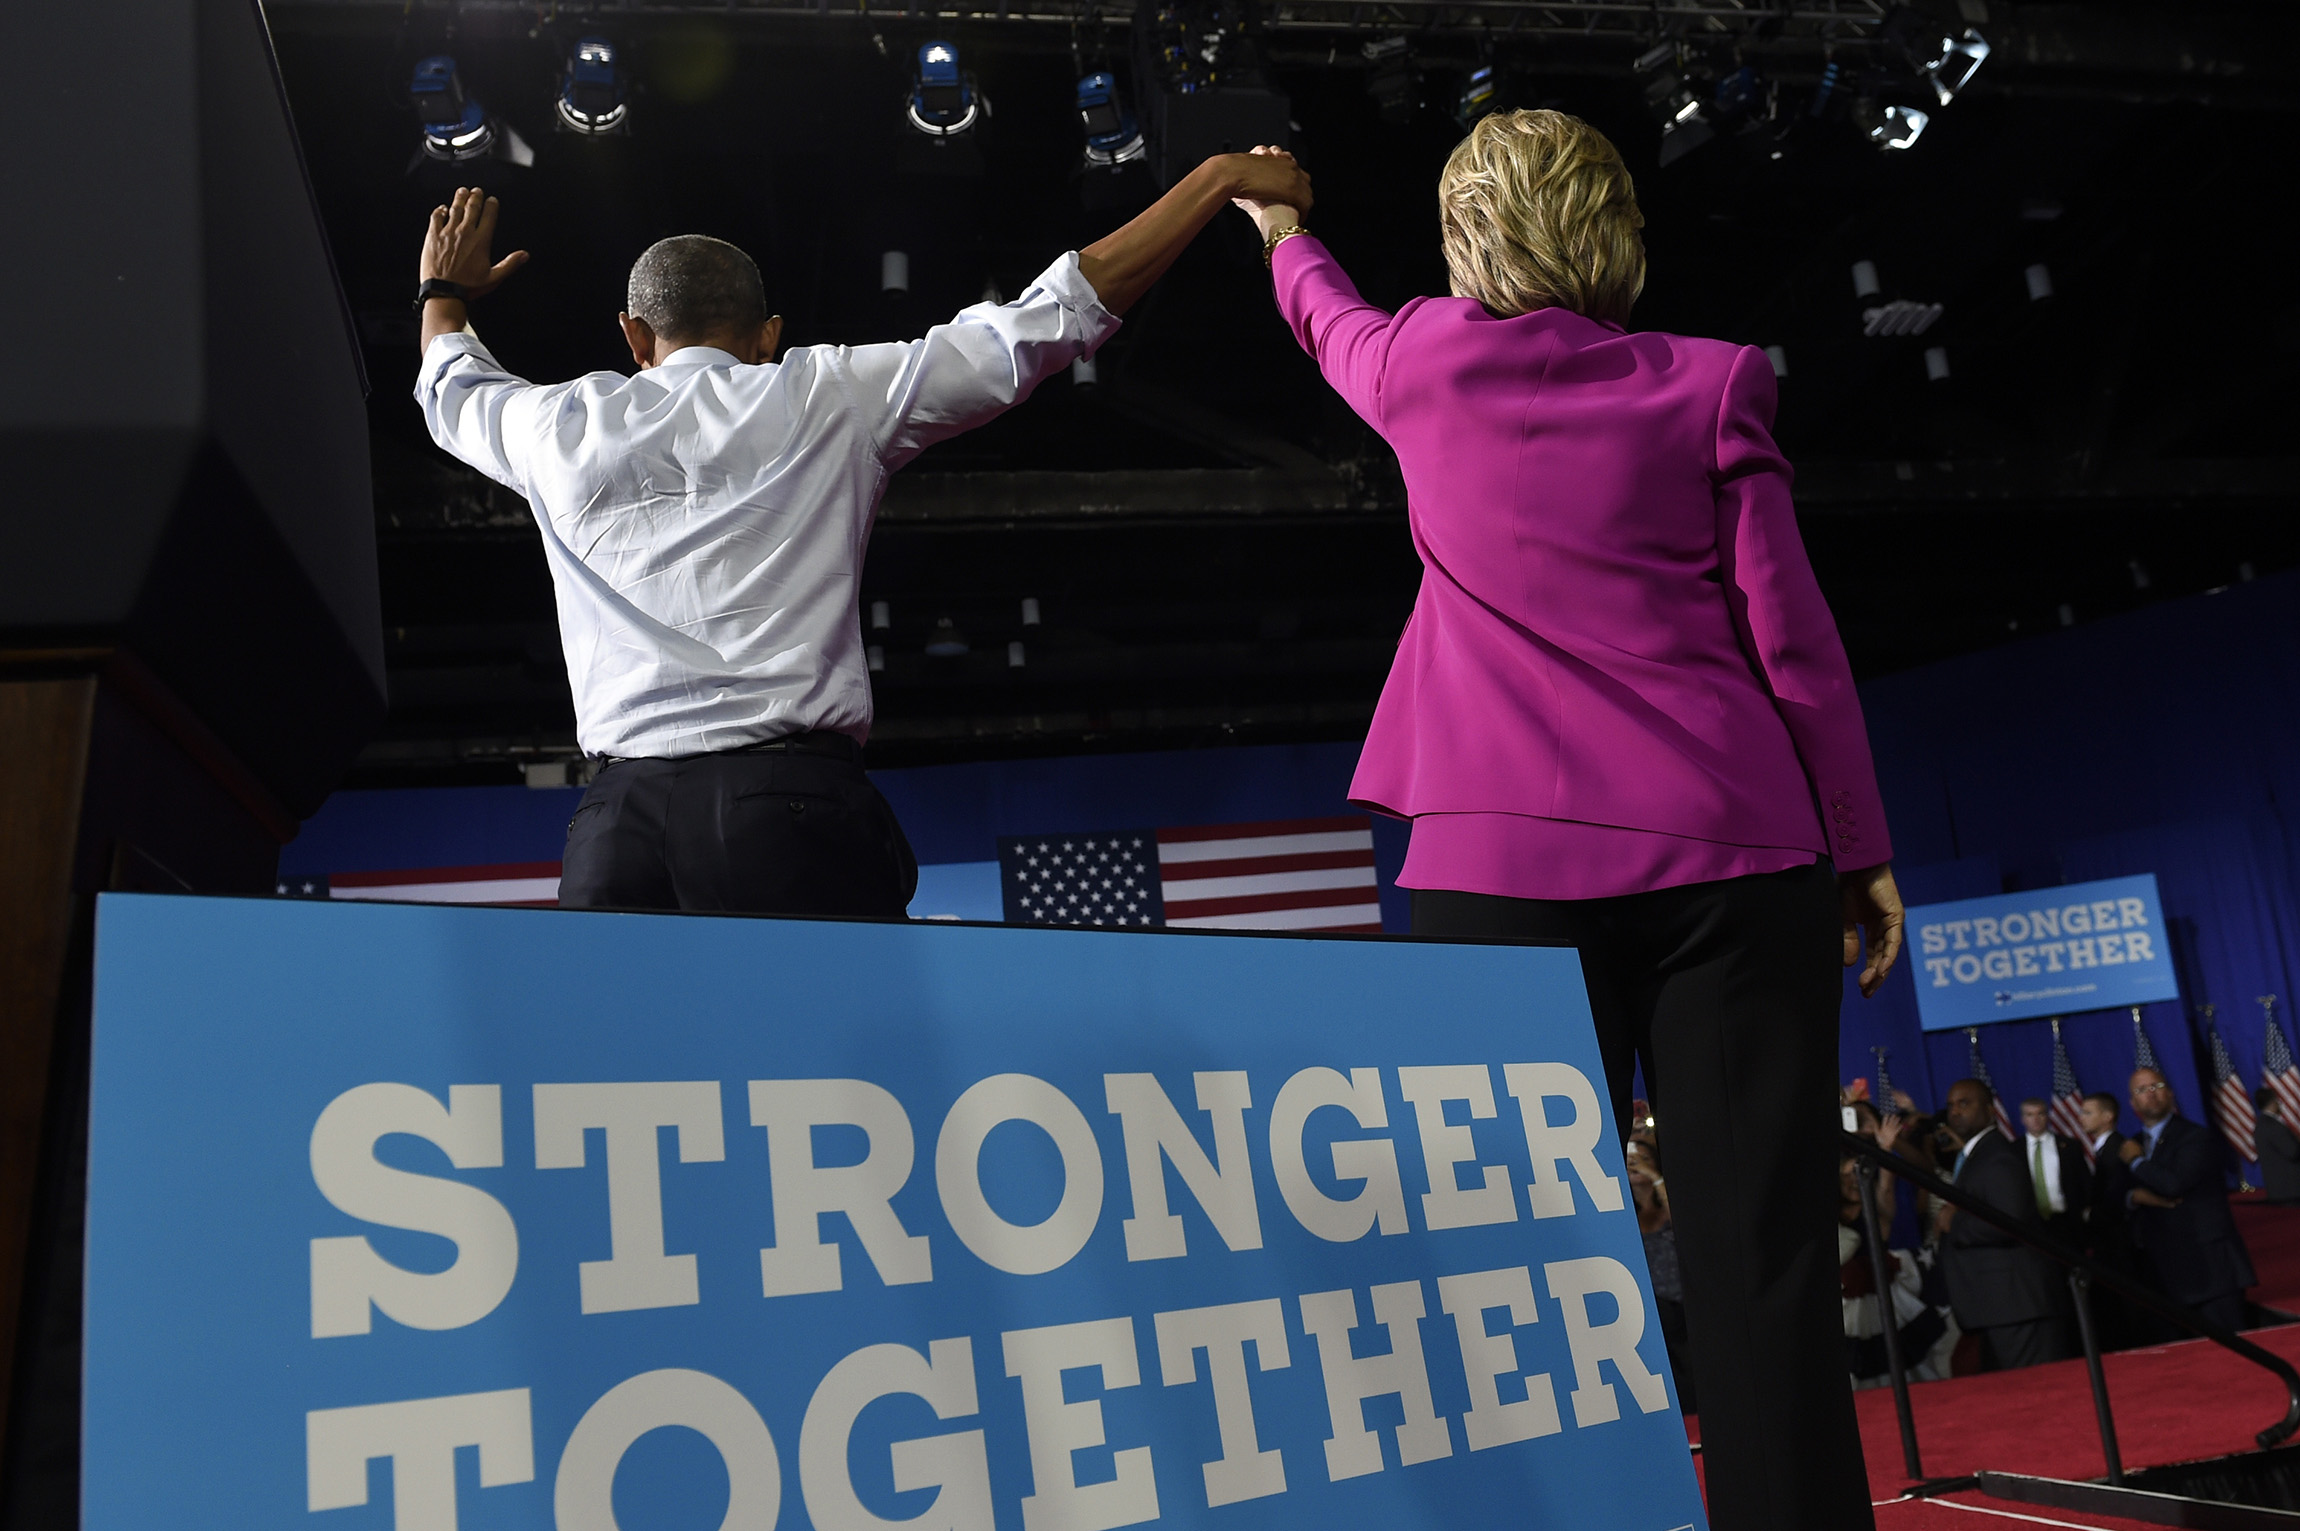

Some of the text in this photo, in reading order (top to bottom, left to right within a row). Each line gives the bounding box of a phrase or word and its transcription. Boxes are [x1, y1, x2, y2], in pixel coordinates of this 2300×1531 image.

[1921, 898, 2148, 954] STRONGER
[1926, 932, 2155, 987] TOGETHER
[309, 1062, 1625, 1338] STRONGER
[306, 1256, 1670, 1531] TOGETHER
